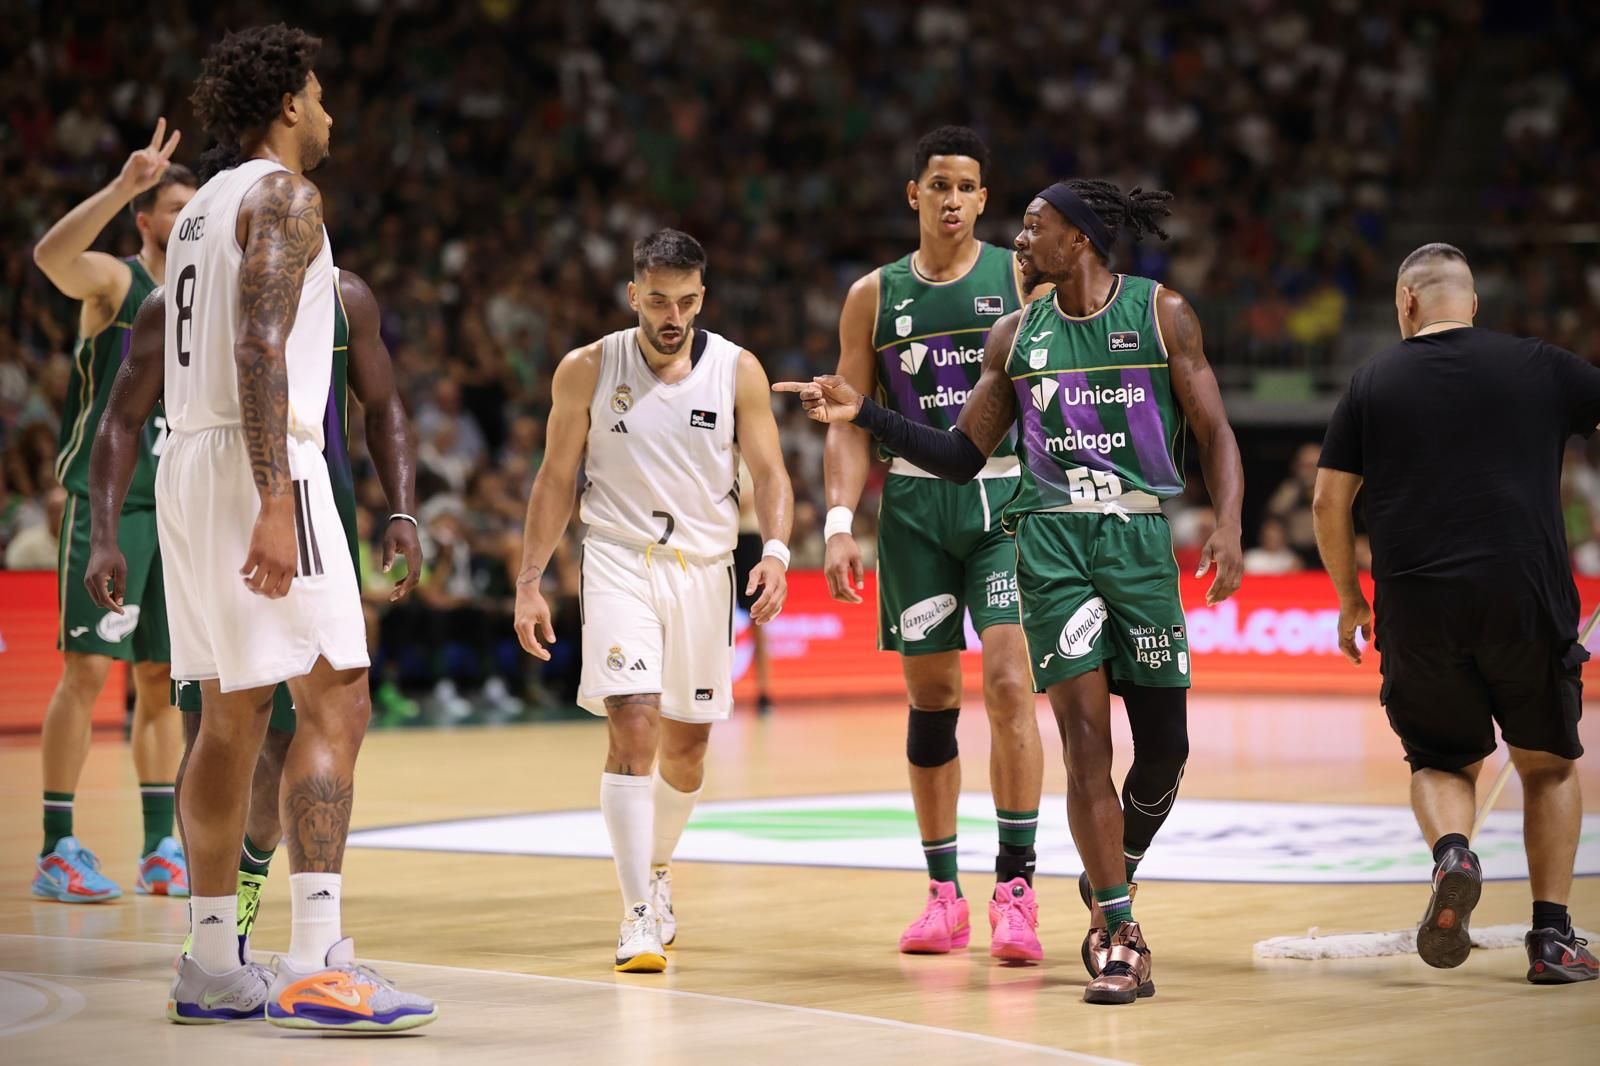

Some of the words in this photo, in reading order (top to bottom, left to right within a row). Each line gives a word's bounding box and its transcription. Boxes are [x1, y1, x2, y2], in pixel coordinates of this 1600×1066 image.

[176, 264, 196, 367] 8
[1064, 383, 1146, 408] Unicaja
[1065, 466, 1122, 504] 55
[652, 510, 675, 545] 7
[1129, 625, 1155, 635] sabor
[1136, 646, 1172, 669] laga
